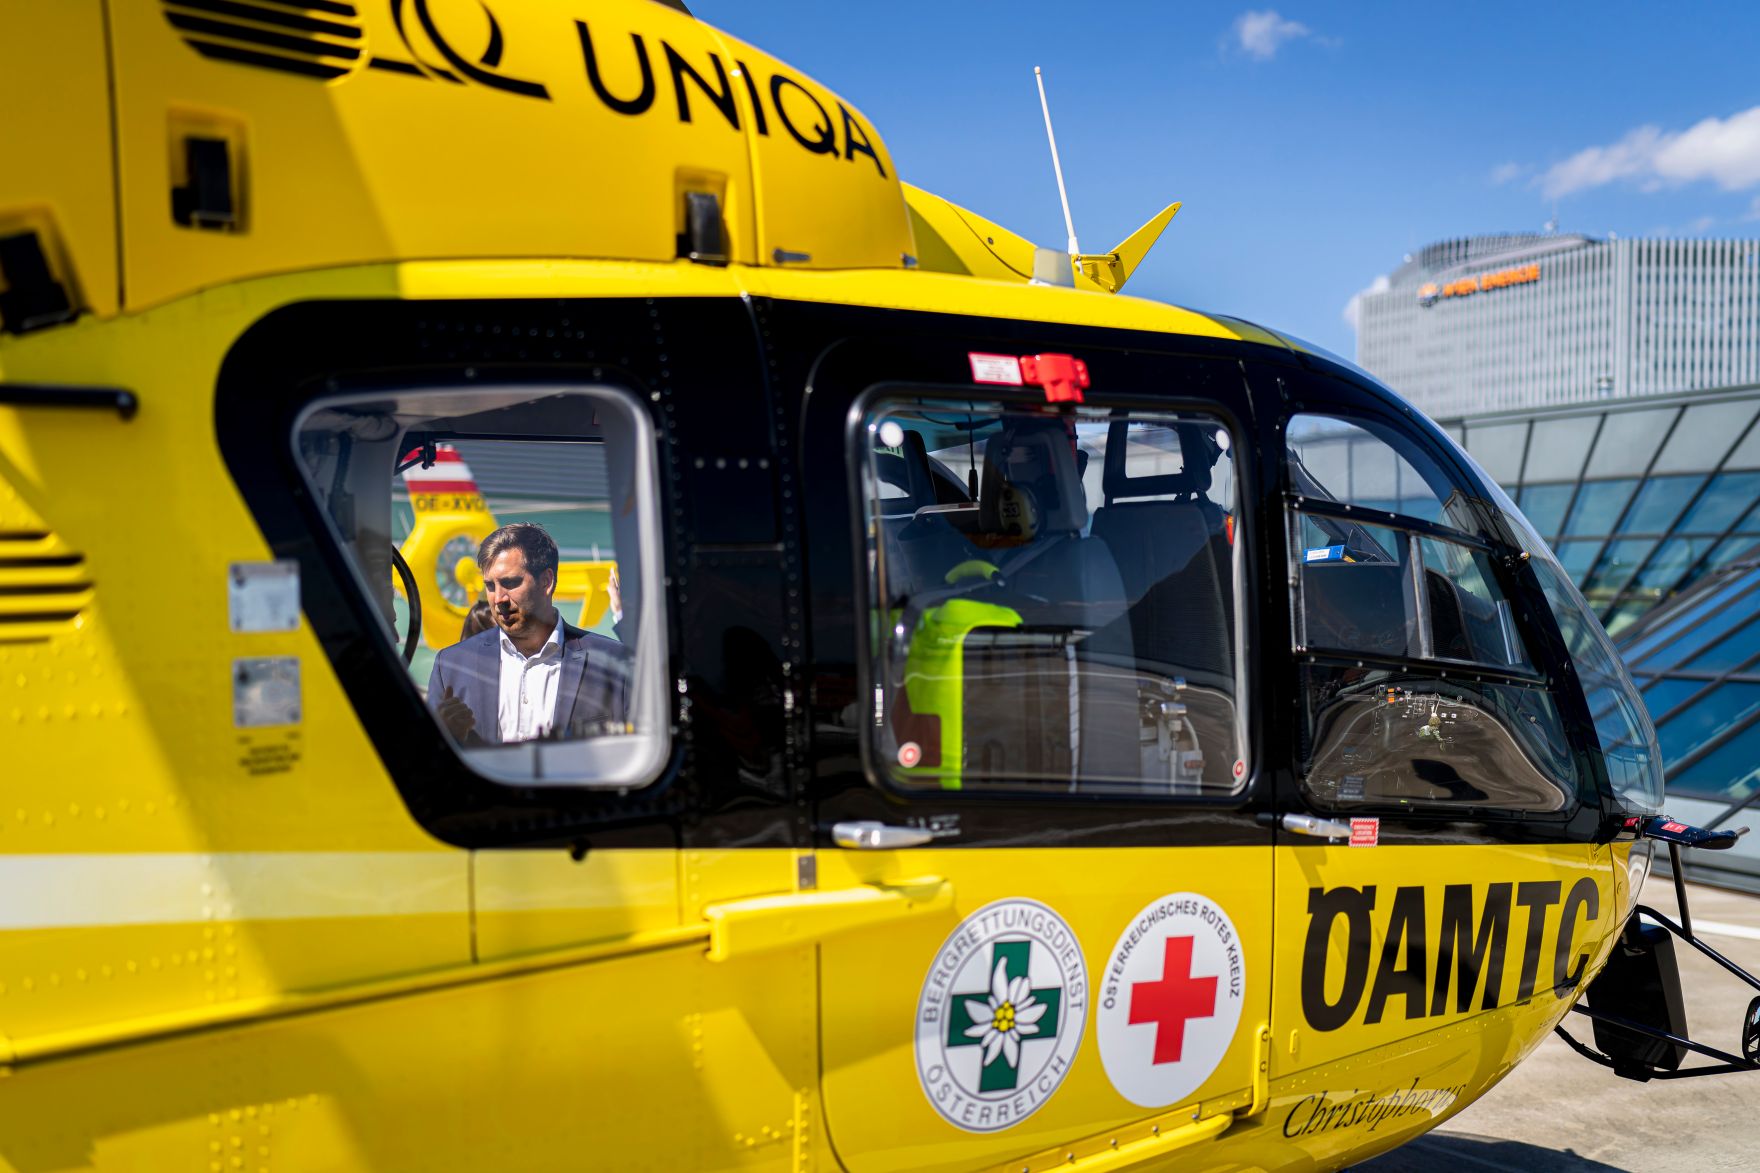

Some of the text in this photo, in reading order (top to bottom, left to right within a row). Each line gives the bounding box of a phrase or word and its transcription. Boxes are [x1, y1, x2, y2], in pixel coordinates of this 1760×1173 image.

[574, 19, 887, 180] UNIQA
[923, 909, 1083, 1024] BERGRETTUNGSDIENST
[1200, 904, 1232, 945] ROTES
[1227, 944, 1241, 999] KREUZ
[1301, 877, 1600, 1032] ÖAMTC
[926, 1055, 1066, 1125] ÖSTERREICH
